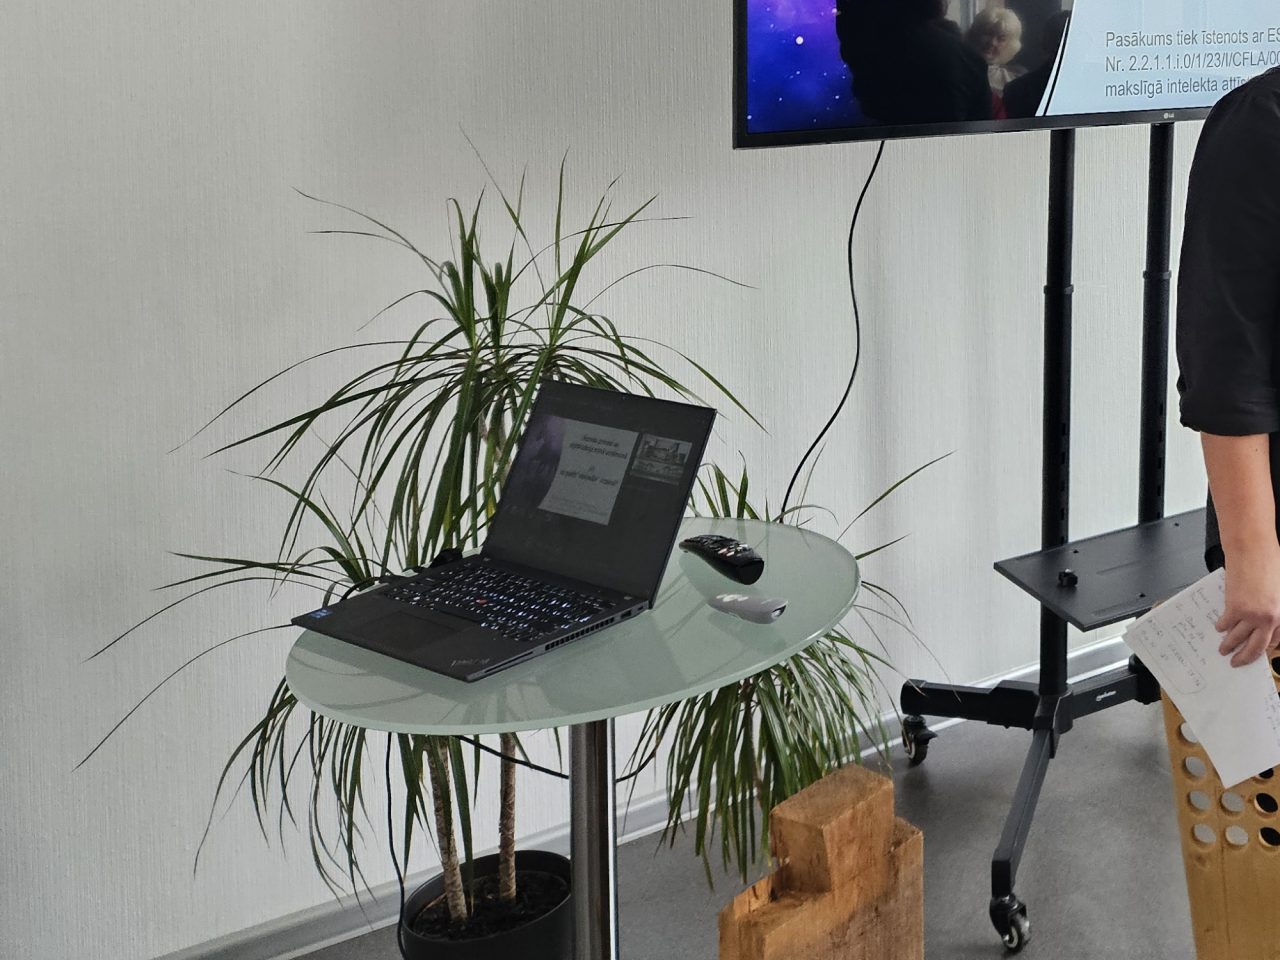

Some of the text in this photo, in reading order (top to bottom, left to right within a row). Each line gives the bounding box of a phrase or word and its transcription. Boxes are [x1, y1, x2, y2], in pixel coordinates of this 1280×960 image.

[1106, 30, 1173, 48] Pasākums
[1177, 29, 1198, 45] tiek
[1201, 29, 1249, 44] īstenots
[1252, 31, 1265, 43] ar
[1105, 56, 1125, 73] Nr.
[1105, 79, 1163, 99] makslīgā
[1167, 77, 1218, 94] intelekta
